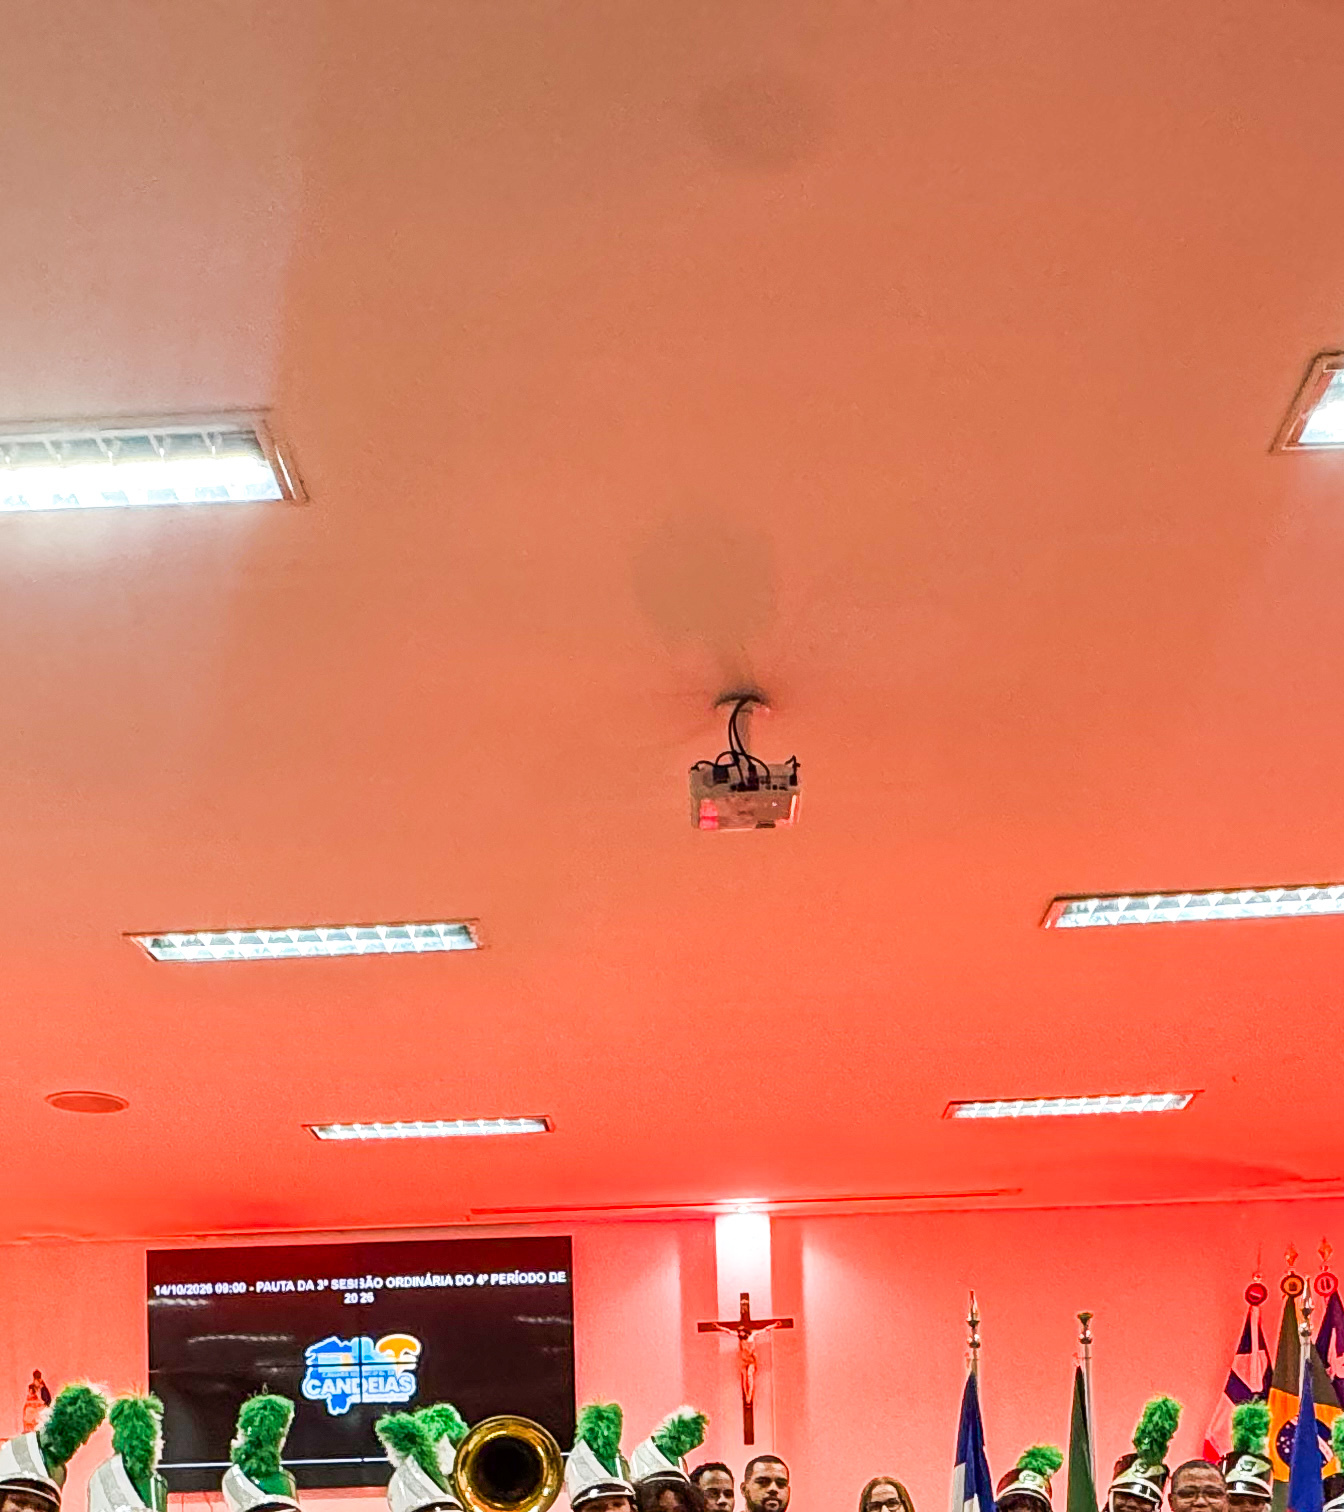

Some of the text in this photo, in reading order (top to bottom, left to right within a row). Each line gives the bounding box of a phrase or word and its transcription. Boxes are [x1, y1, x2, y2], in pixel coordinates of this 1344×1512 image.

[256, 1280, 295, 1293] PAUTA
[297, 1279, 315, 1291] DA
[386, 1272, 454, 1288] ORDINÁRIA
[456, 1274, 474, 1286] DO
[490, 1270, 547, 1286] PERÍODO
[549, 1271, 567, 1283] DE
[306, 1375, 413, 1395] CANDEIAS
